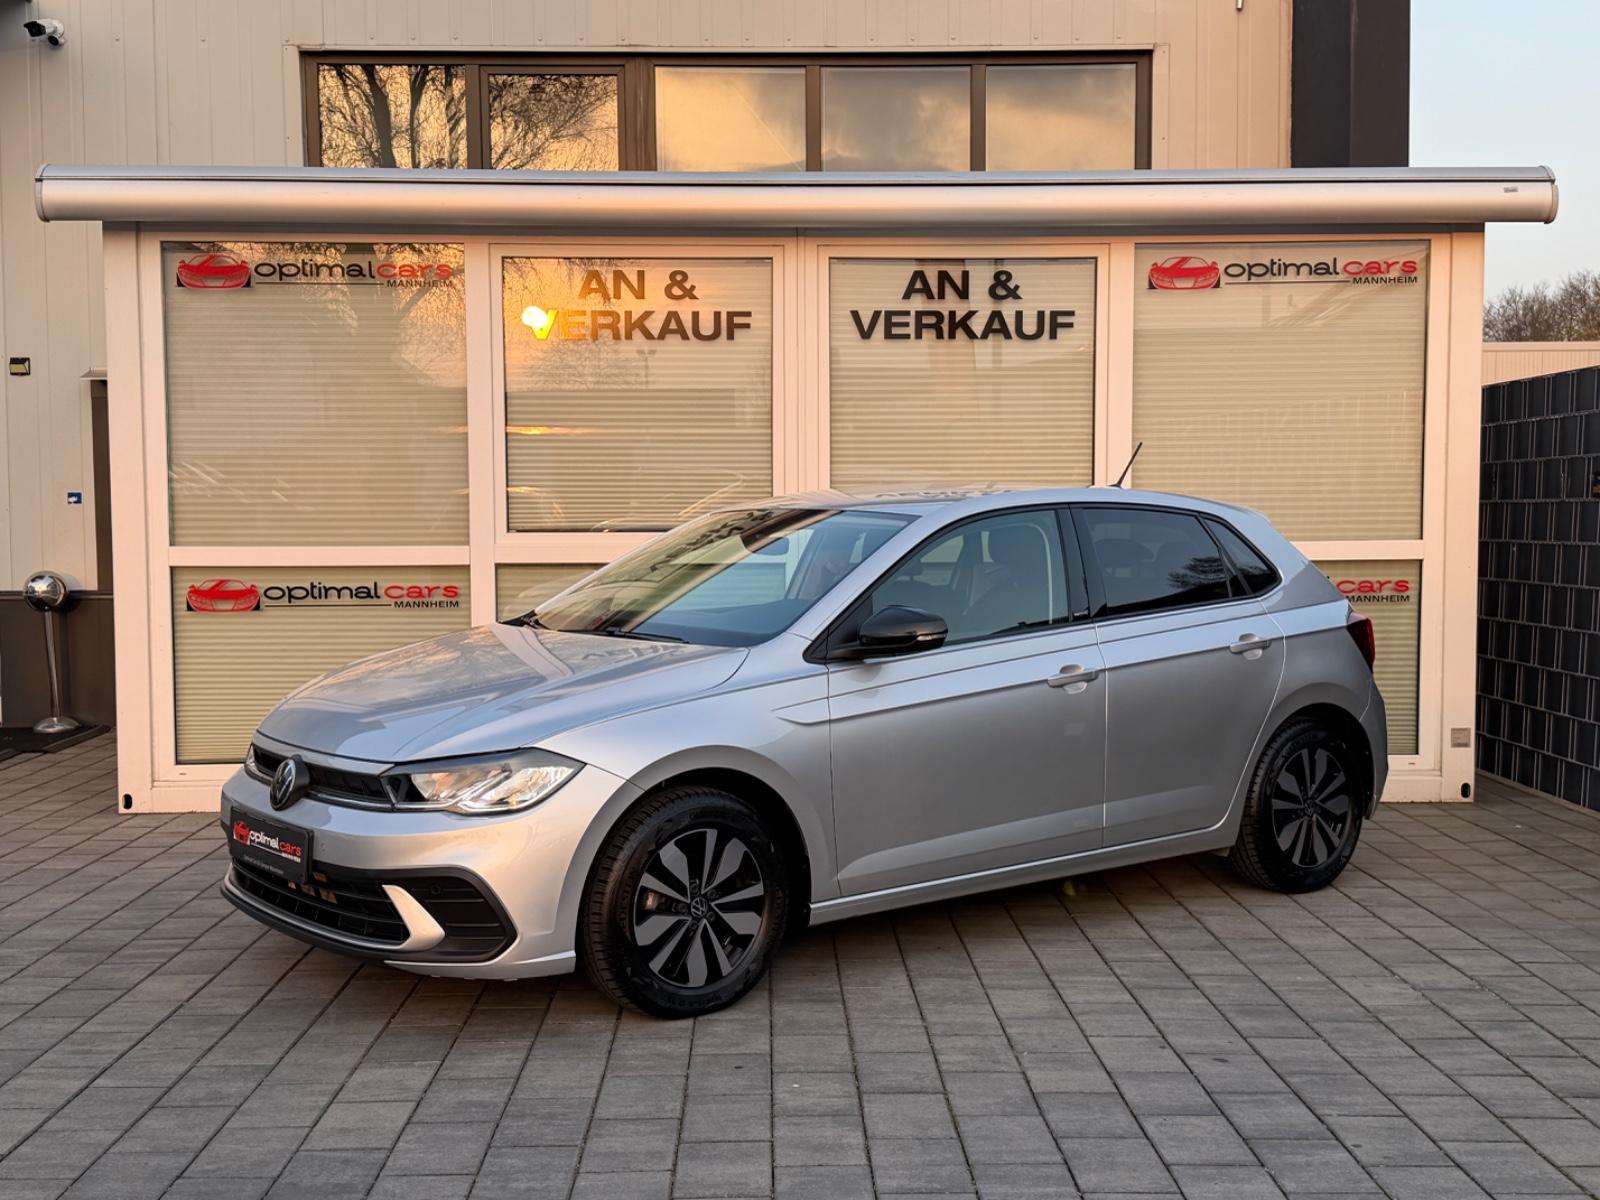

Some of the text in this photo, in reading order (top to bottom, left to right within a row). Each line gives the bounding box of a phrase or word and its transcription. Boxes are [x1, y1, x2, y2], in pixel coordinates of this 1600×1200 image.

[386, 279, 452, 288] MANNHEIM
[578, 269, 699, 300] AN &
[901, 269, 1022, 300] AN &
[1352, 275, 1418, 285] MANNHEIM
[525, 310, 752, 341] VERKAUF
[850, 309, 1075, 340] VERKAUF
[394, 600, 459, 609] MANNHEIM
[1345, 594, 1410, 602] MANNHEIM
